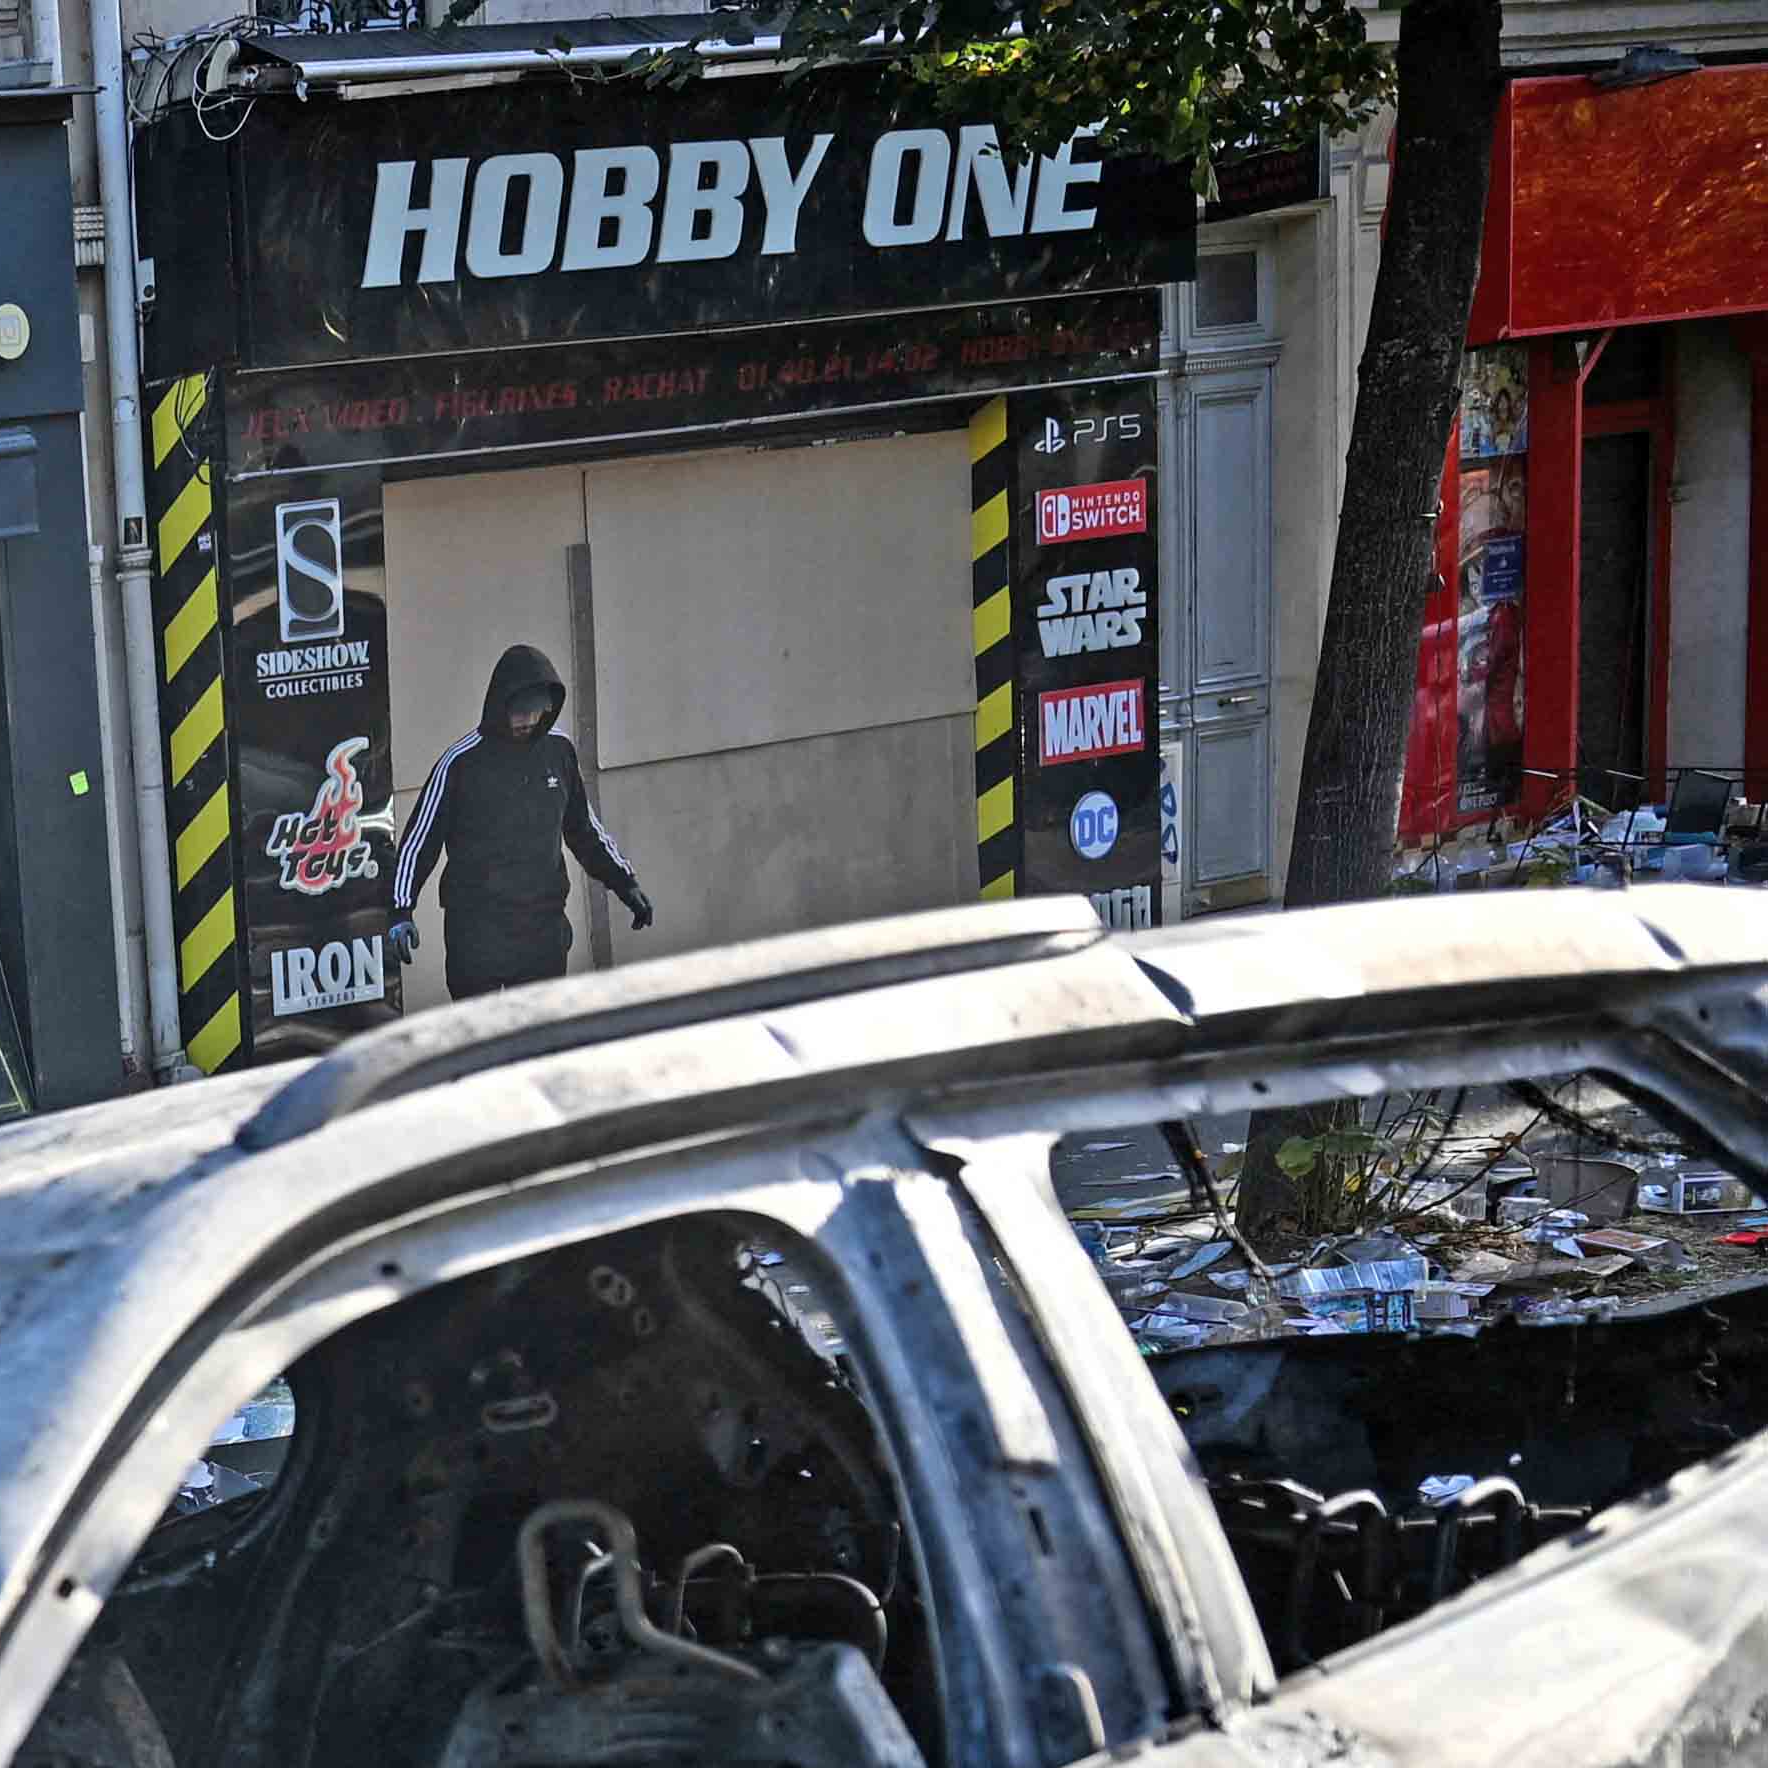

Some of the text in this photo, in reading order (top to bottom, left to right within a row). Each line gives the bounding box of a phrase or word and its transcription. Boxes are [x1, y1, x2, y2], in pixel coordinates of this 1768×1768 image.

[360, 123, 1103, 289] HOBBY ONE
[1073, 414, 1142, 444] PS5
[1071, 492, 1140, 509] NINTENDO
[1071, 507, 1142, 529] SWITCH
[1037, 567, 1146, 617] STAR
[1038, 606, 1146, 658] WARS
[257, 640, 370, 678] SIDESHOW
[265, 673, 364, 698] COLLECTIBLES
[1044, 689, 1142, 758] MARVEL
[1076, 808, 1116, 848] DC
[271, 936, 384, 1014] IRON
